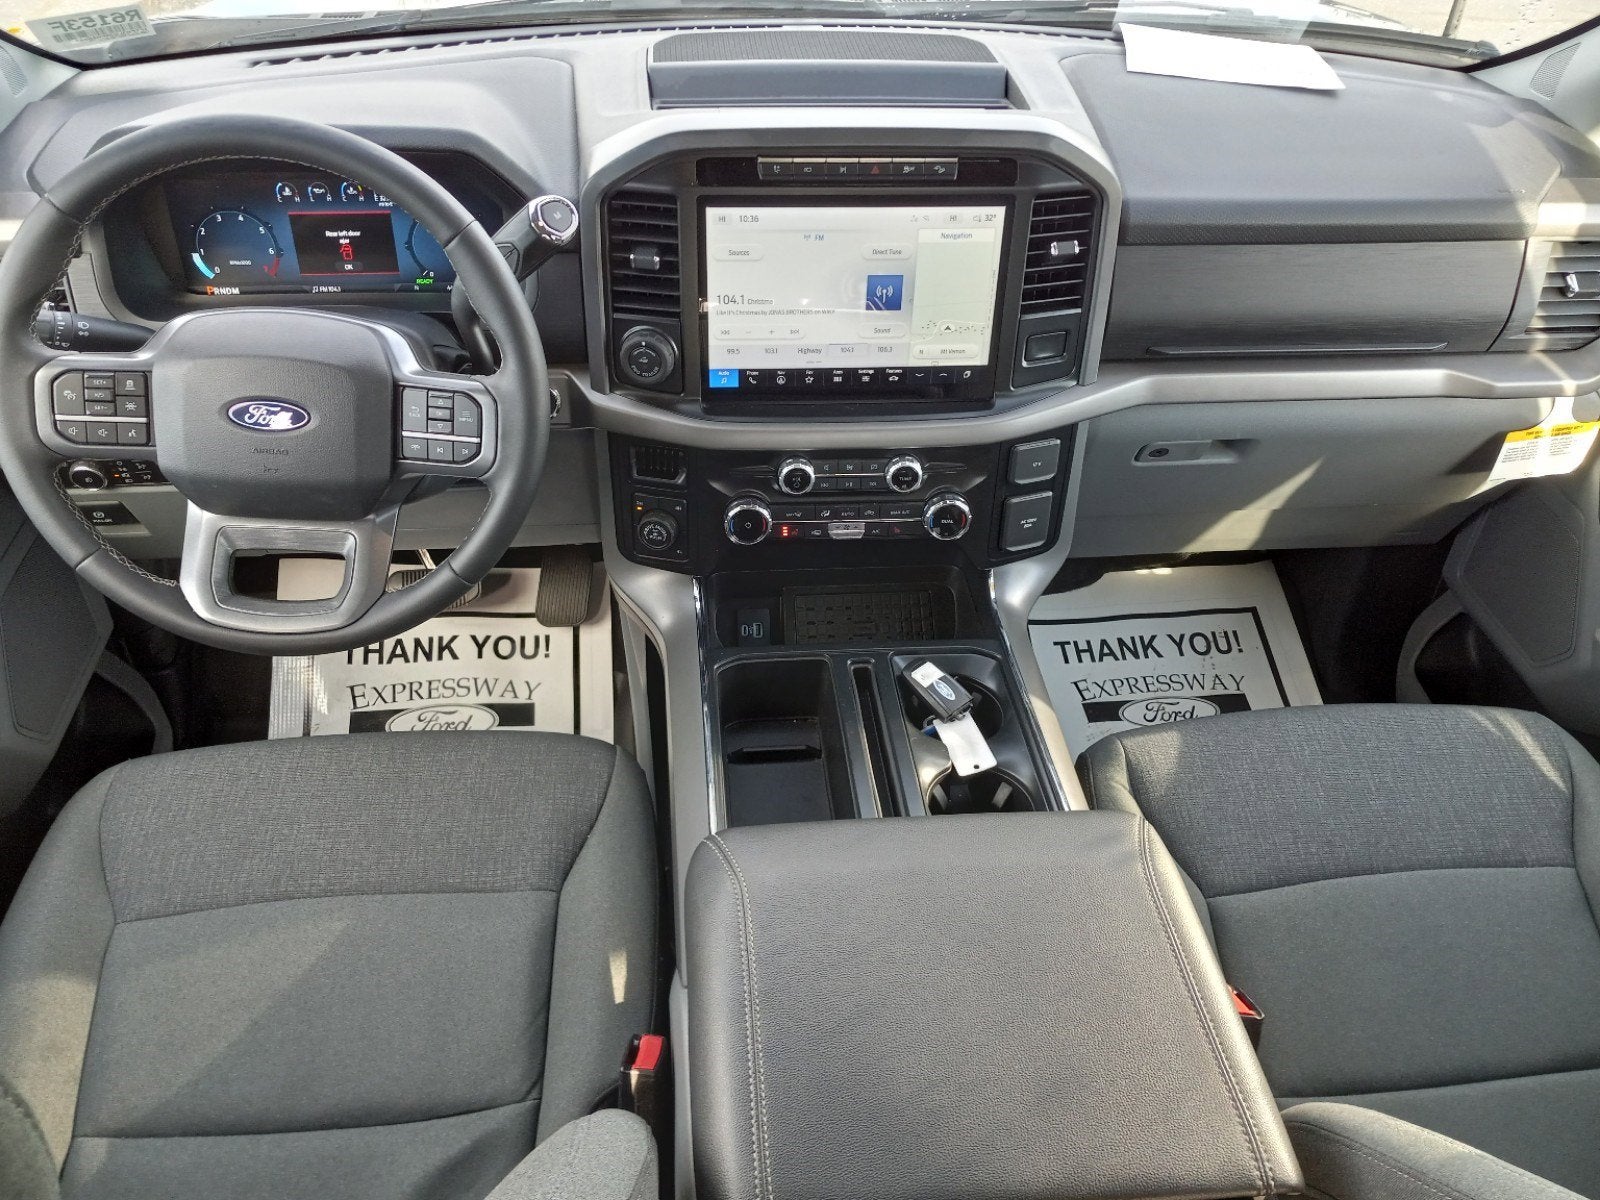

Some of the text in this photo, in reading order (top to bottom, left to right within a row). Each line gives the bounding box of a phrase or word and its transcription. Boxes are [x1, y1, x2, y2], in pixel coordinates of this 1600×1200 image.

[739, 215, 760, 223] 10:36
[940, 231, 973, 240] Navigation
[716, 294, 746, 305] 104.1
[797, 347, 822, 355] Highway
[471, 634, 551, 660] YOU!
[1053, 629, 1244, 664] THANK YOU!
[346, 676, 543, 710] EXPRESSWAY
[1070, 672, 1246, 700] EXPRESSWAY
[410, 709, 472, 731] Ford
[1143, 700, 1199, 722] Ford
